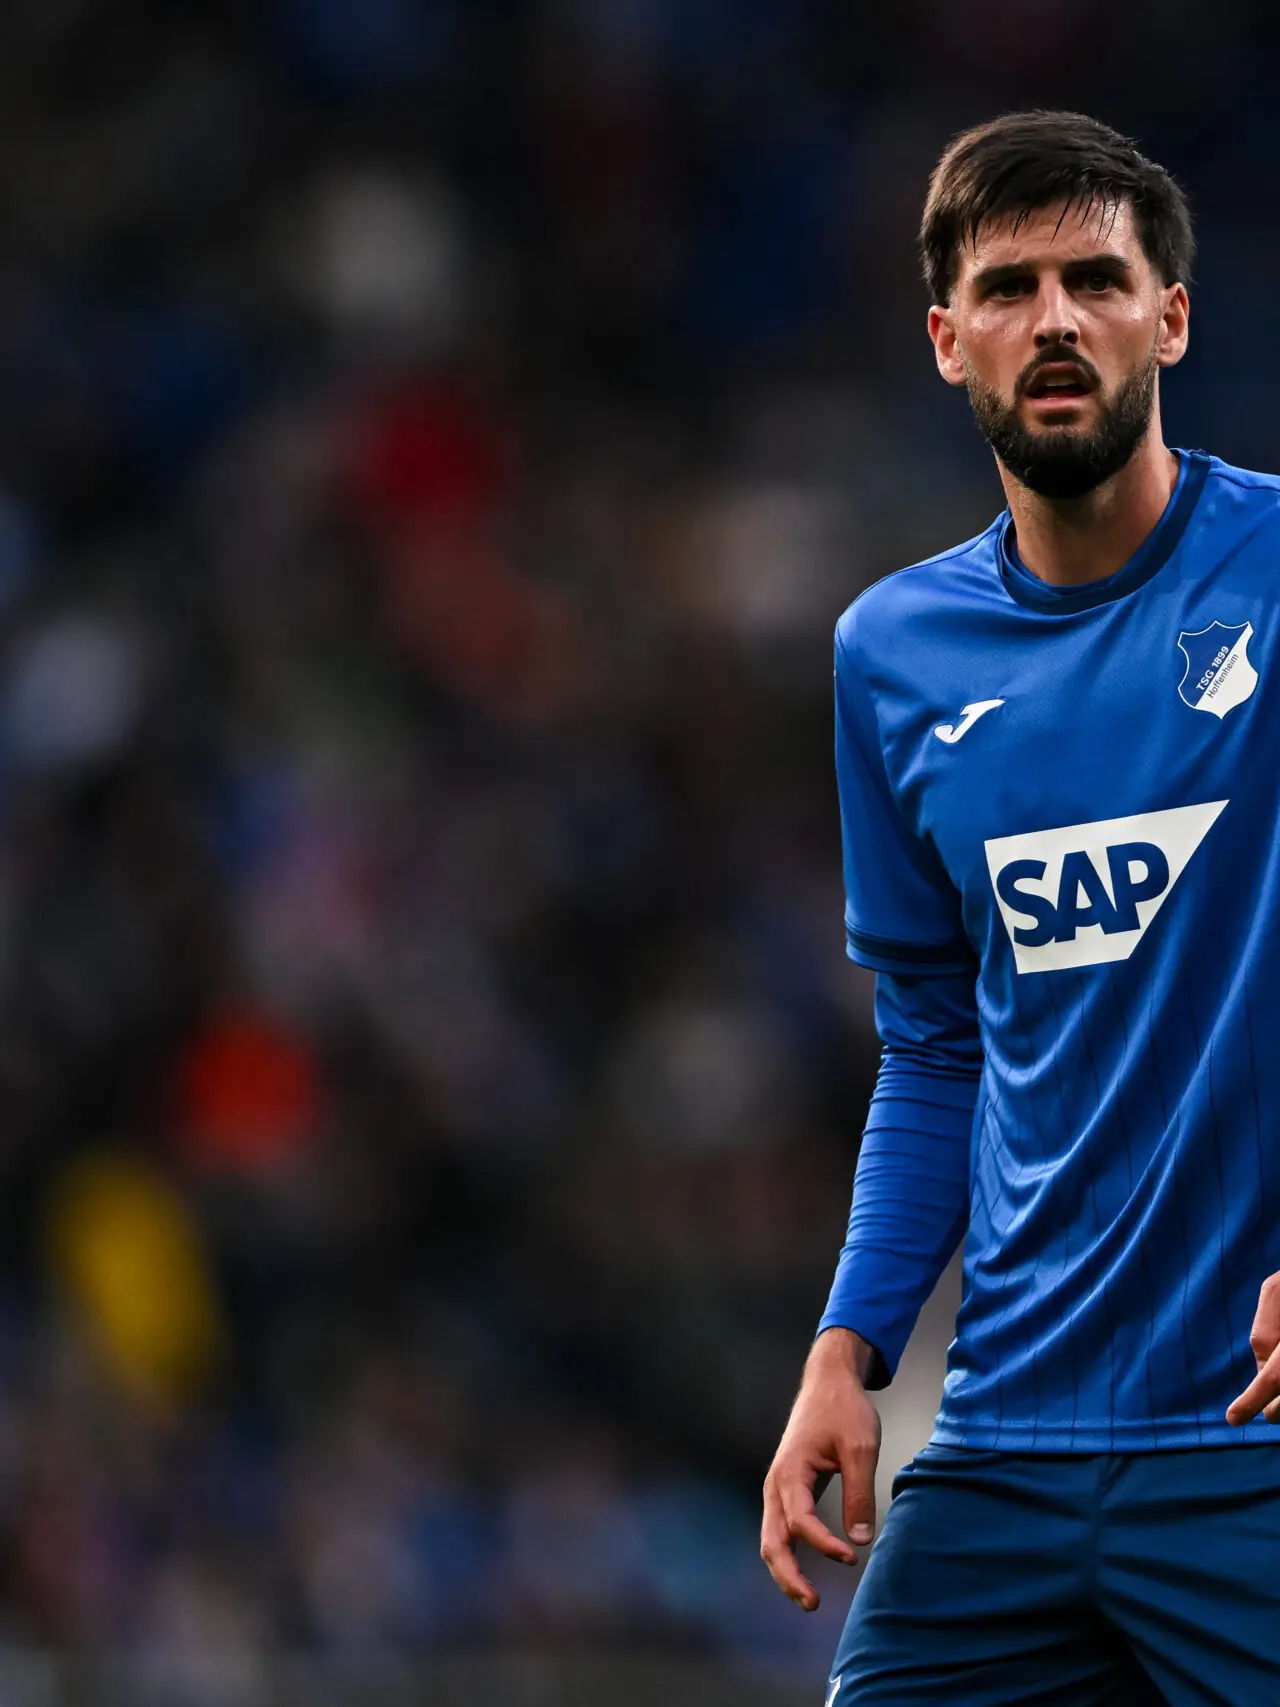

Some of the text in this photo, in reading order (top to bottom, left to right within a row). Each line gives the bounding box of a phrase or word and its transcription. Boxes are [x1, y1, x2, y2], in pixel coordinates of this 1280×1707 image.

[1196, 645, 1230, 691] TSG 1899
[1207, 653, 1239, 699] Hoffenheim
[996, 841, 1170, 947] SAP
